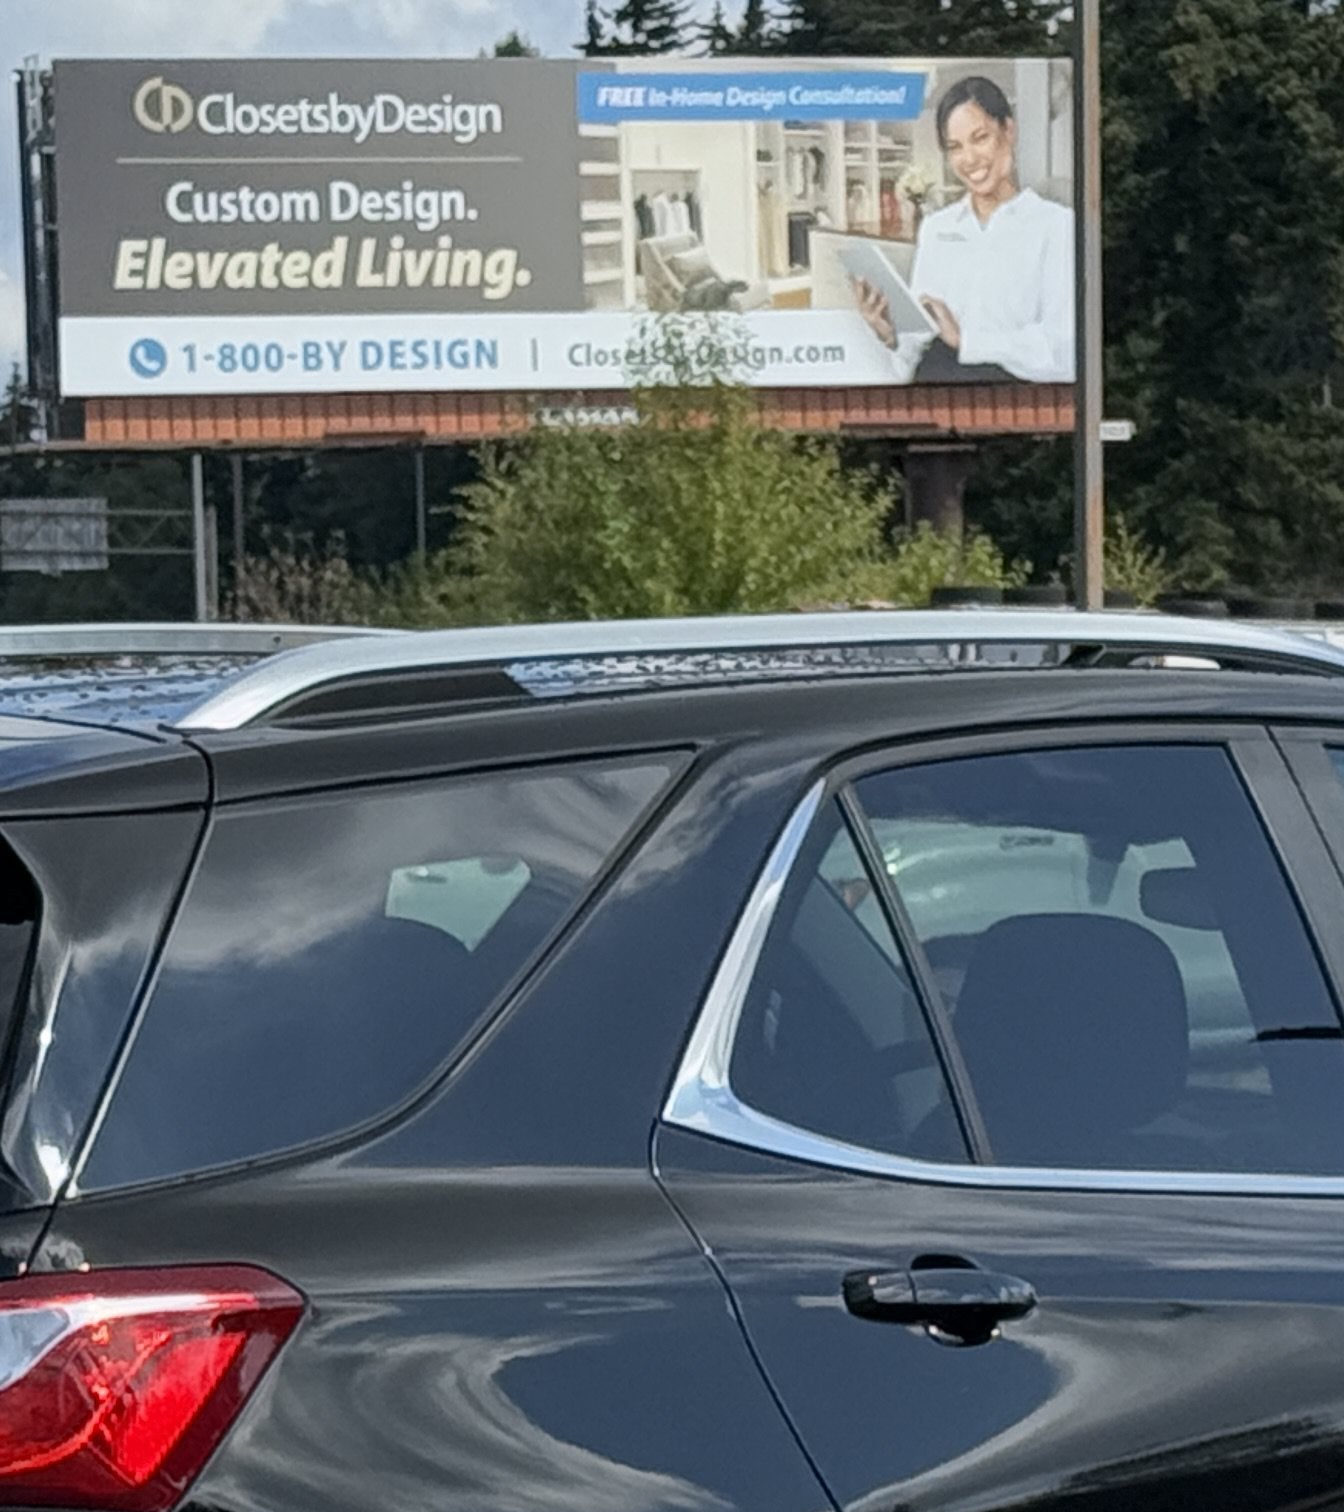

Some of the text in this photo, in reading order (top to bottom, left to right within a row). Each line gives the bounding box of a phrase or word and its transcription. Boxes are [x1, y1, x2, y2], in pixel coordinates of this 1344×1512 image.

[197, 93, 502, 144] ClosetsbyDesign
[165, 180, 479, 232] Custom Design.
[113, 234, 533, 300] Elevated Living.
[180, 338, 499, 374] 1-800-BY DESIGN
